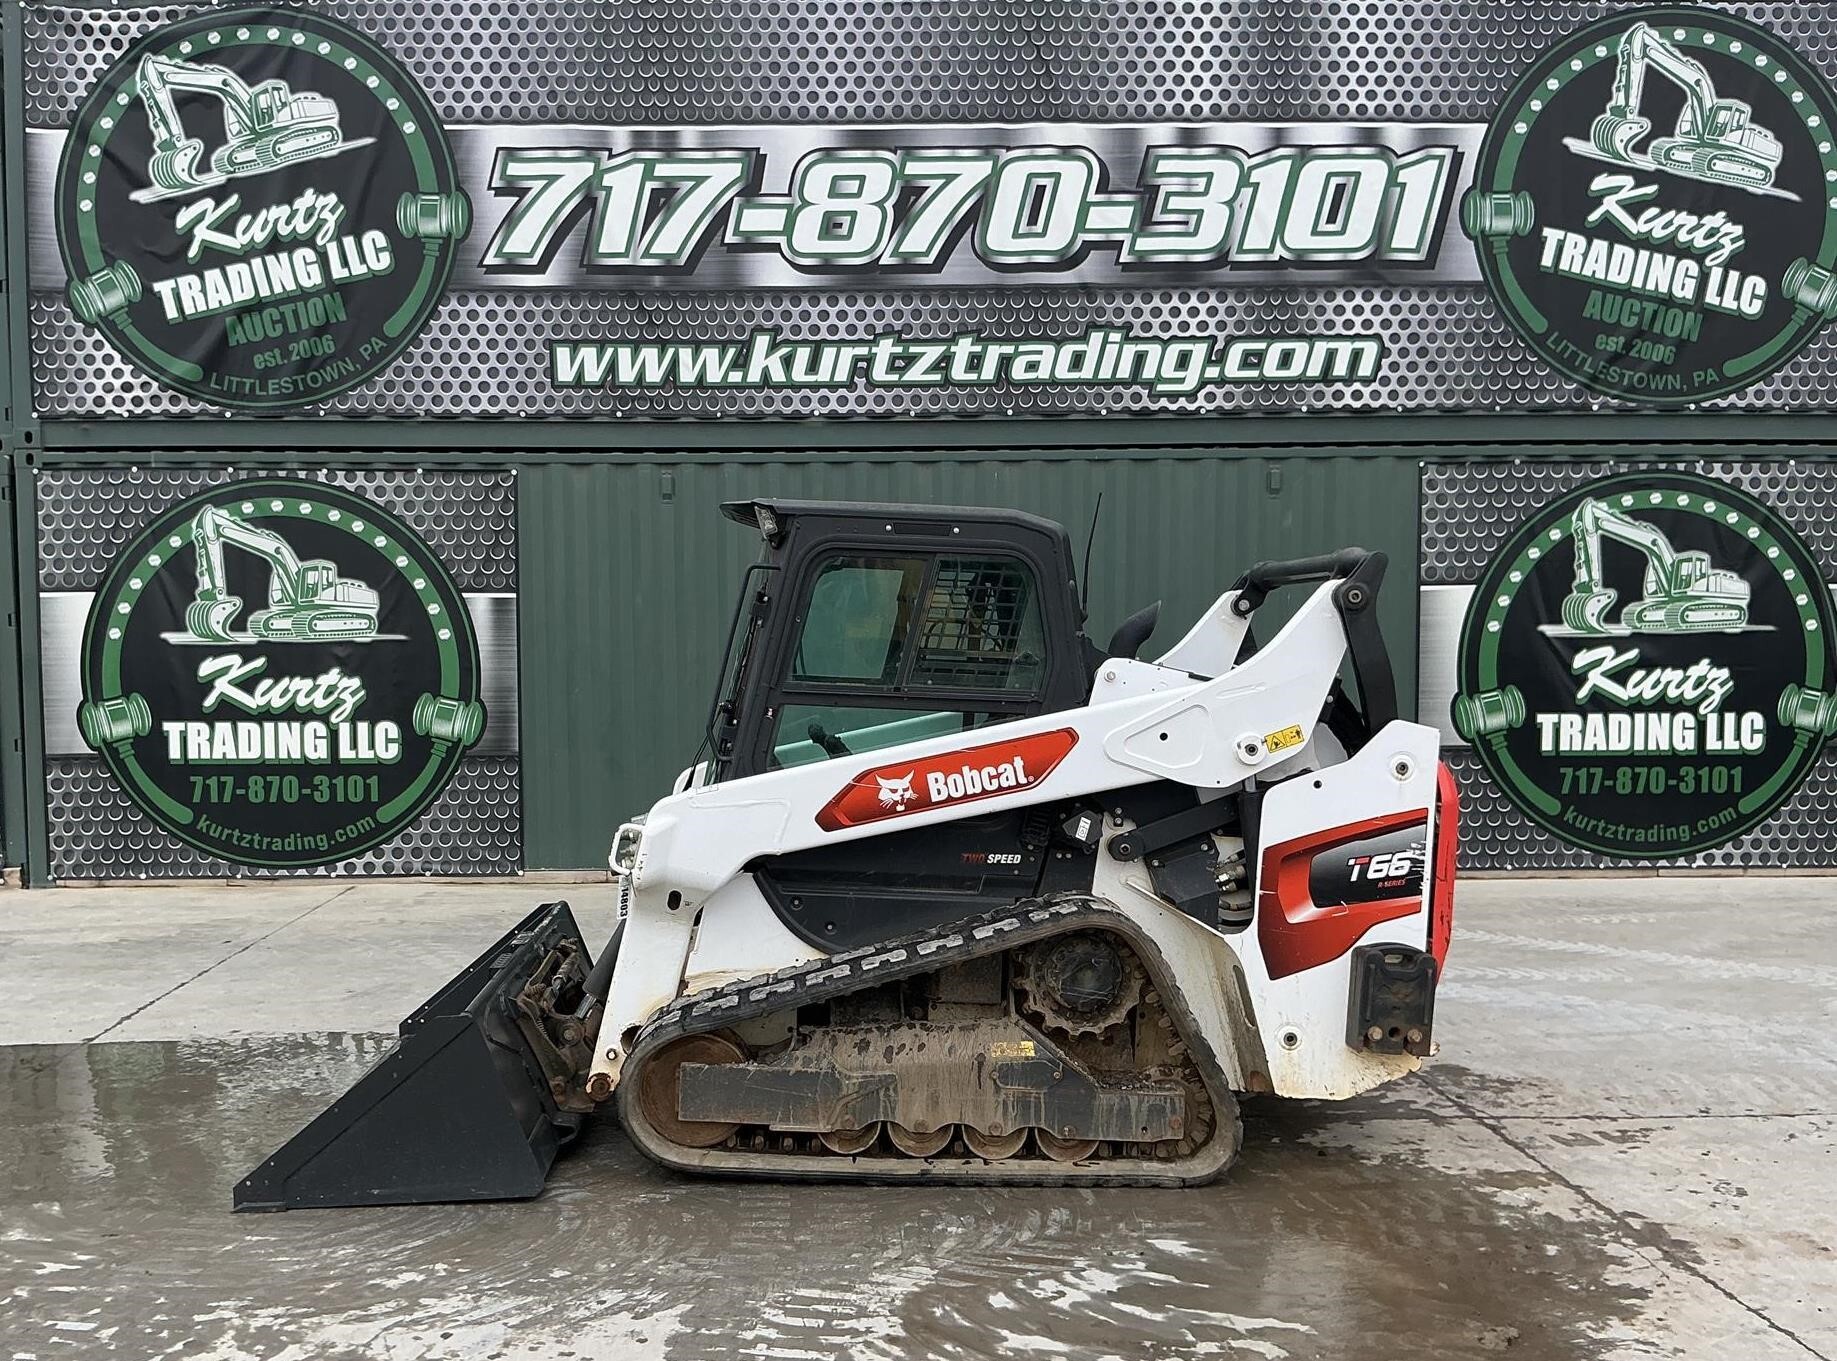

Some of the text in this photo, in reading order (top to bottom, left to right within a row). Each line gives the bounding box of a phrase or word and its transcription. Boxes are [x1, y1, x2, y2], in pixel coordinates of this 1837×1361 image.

[174, 187, 345, 262] Kurtz
[485, 147, 1456, 268] 717-870-3101
[1585, 173, 1746, 267] Kurtz
[153, 229, 392, 322] TRADING LLC
[1539, 226, 1767, 318] TRADING LLC
[225, 290, 347, 347] AUCTION
[1582, 290, 1703, 343] AUCTION
[209, 336, 388, 397] LITTLESTOWN, PA
[252, 335, 336, 371] est. 2006
[552, 333, 1381, 393] www.kurtztrading.com
[1545, 331, 1720, 393] LITTLESTOWN, PA
[1594, 332, 1676, 366] est. 2006
[197, 653, 367, 722] Kurtz
[1571, 644, 1735, 714] Kurtz
[163, 720, 402, 765] TRADING LLC
[1536, 711, 1766, 756] TRADING LLC
[189, 774, 380, 805] 717-870-3101
[926, 755, 1028, 803] Bobcat
[1559, 765, 1743, 796] 717-870-3101
[196, 814, 377, 853] kurtztrading.com
[1563, 806, 1738, 844] kurtztrading.com
[986, 852, 1022, 864] SPEED
[1347, 851, 1412, 882] T66
[620, 886, 629, 917] 14803
